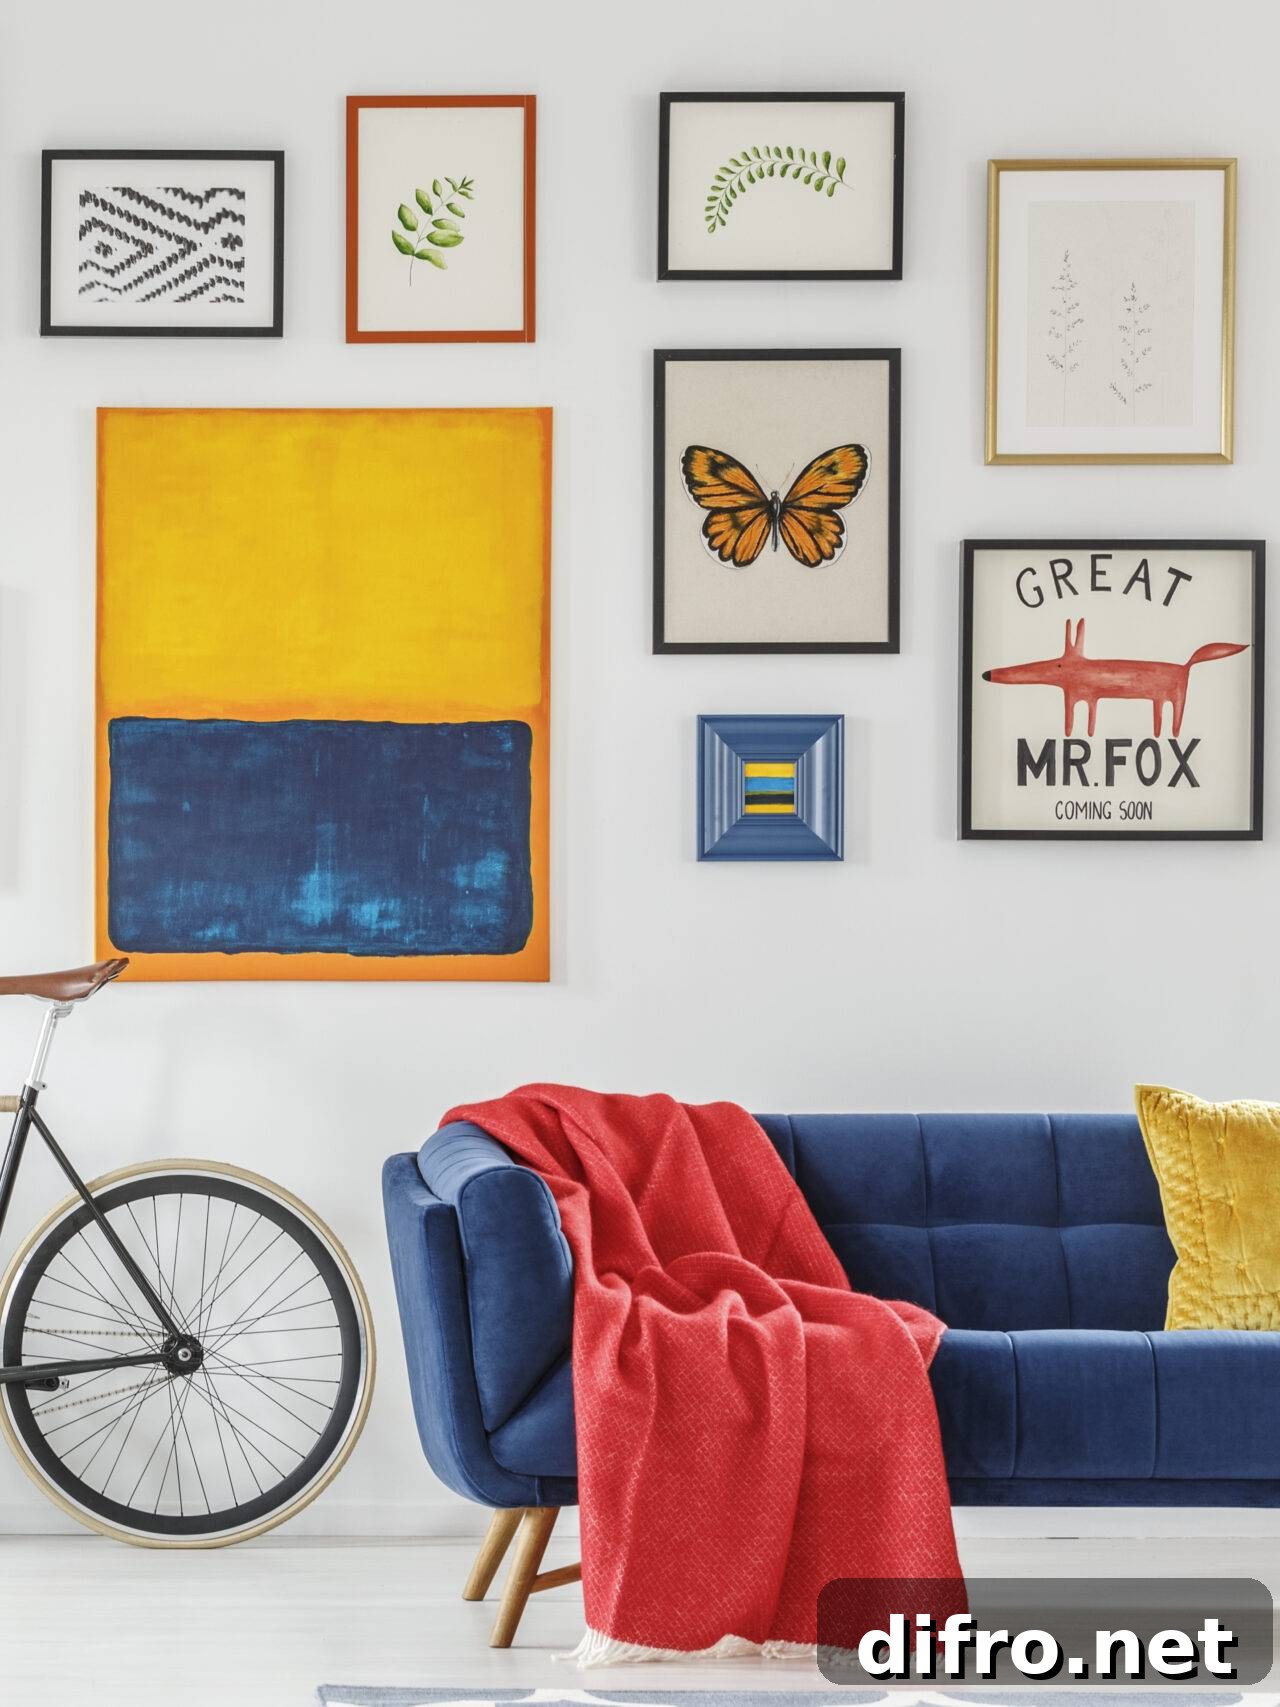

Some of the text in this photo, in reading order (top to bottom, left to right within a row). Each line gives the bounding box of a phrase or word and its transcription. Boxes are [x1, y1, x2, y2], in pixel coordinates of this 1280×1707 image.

[1016, 553, 1192, 608] GREAT
[1055, 800, 1153, 820] COMING SOON
